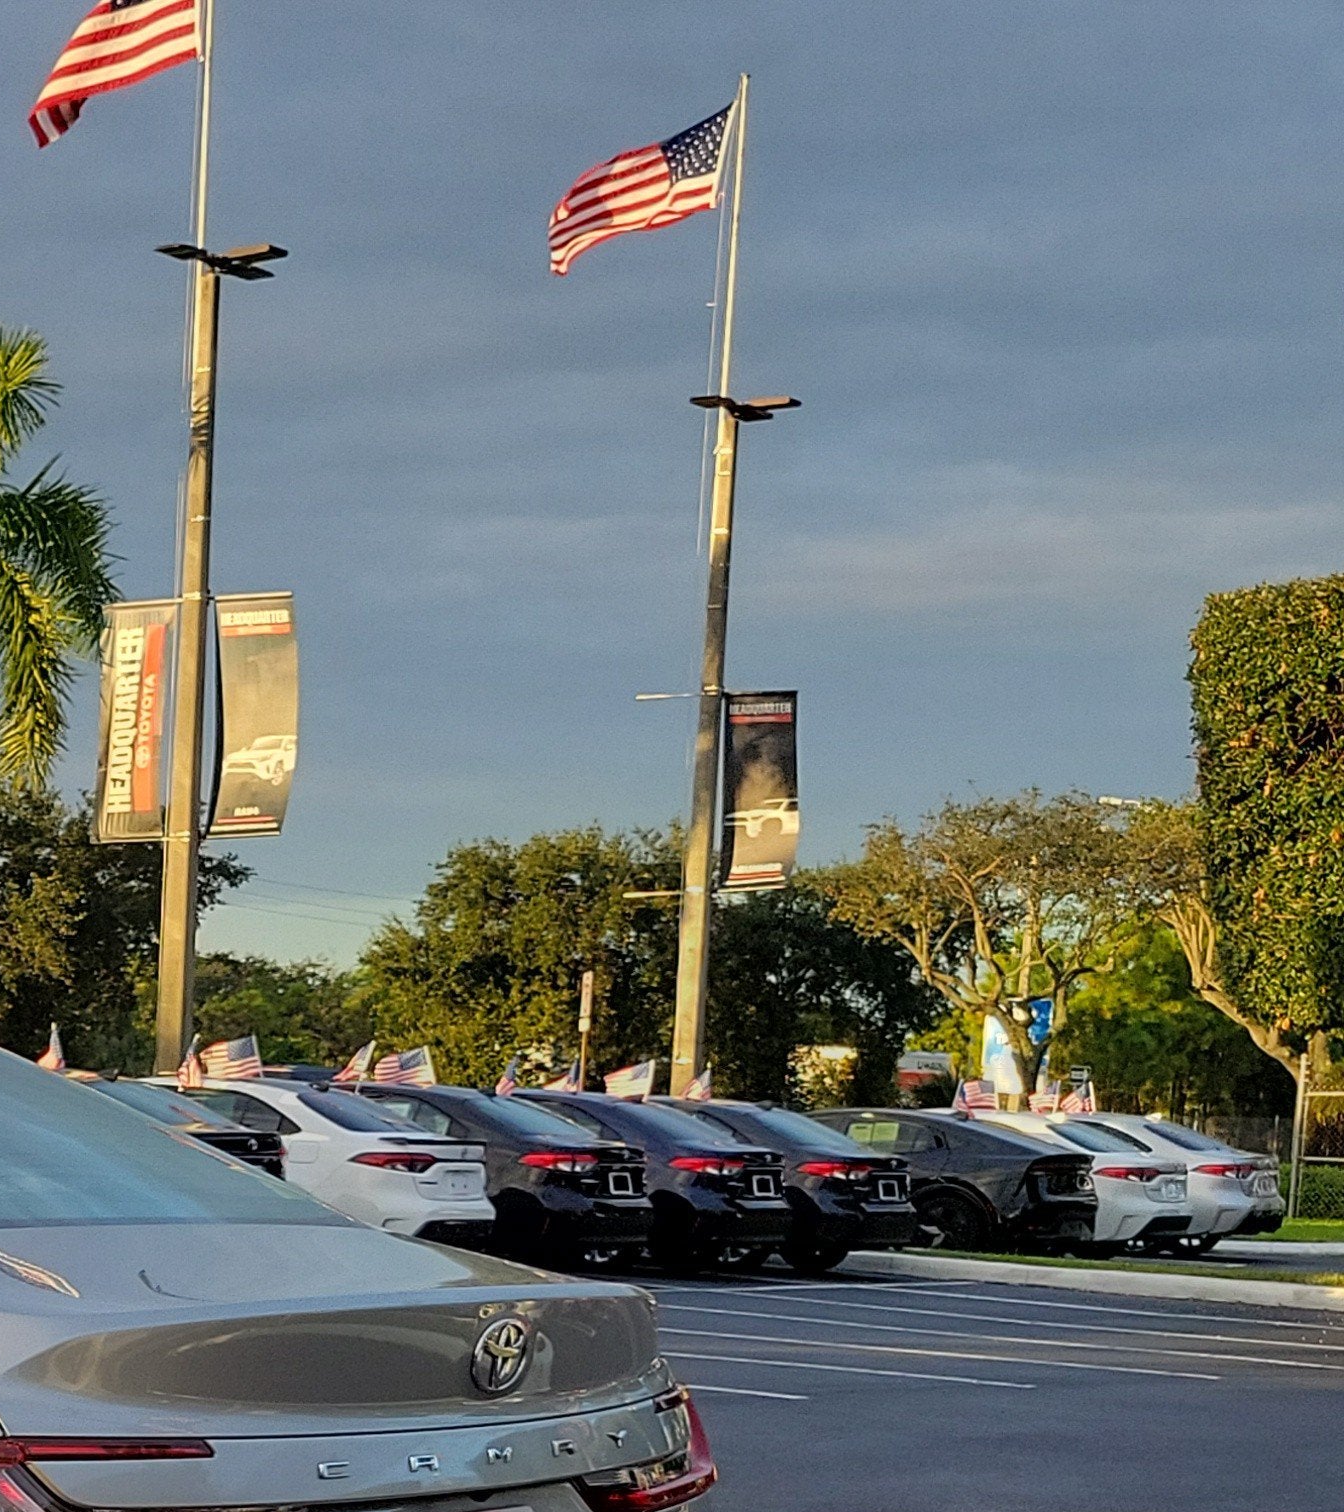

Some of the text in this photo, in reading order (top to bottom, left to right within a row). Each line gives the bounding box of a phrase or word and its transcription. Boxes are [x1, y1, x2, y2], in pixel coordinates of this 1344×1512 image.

[107, 627, 144, 814] HEADQUARTER
[137, 673, 157, 746] TOYOTA
[317, 1431, 627, 1480] CAMRY
